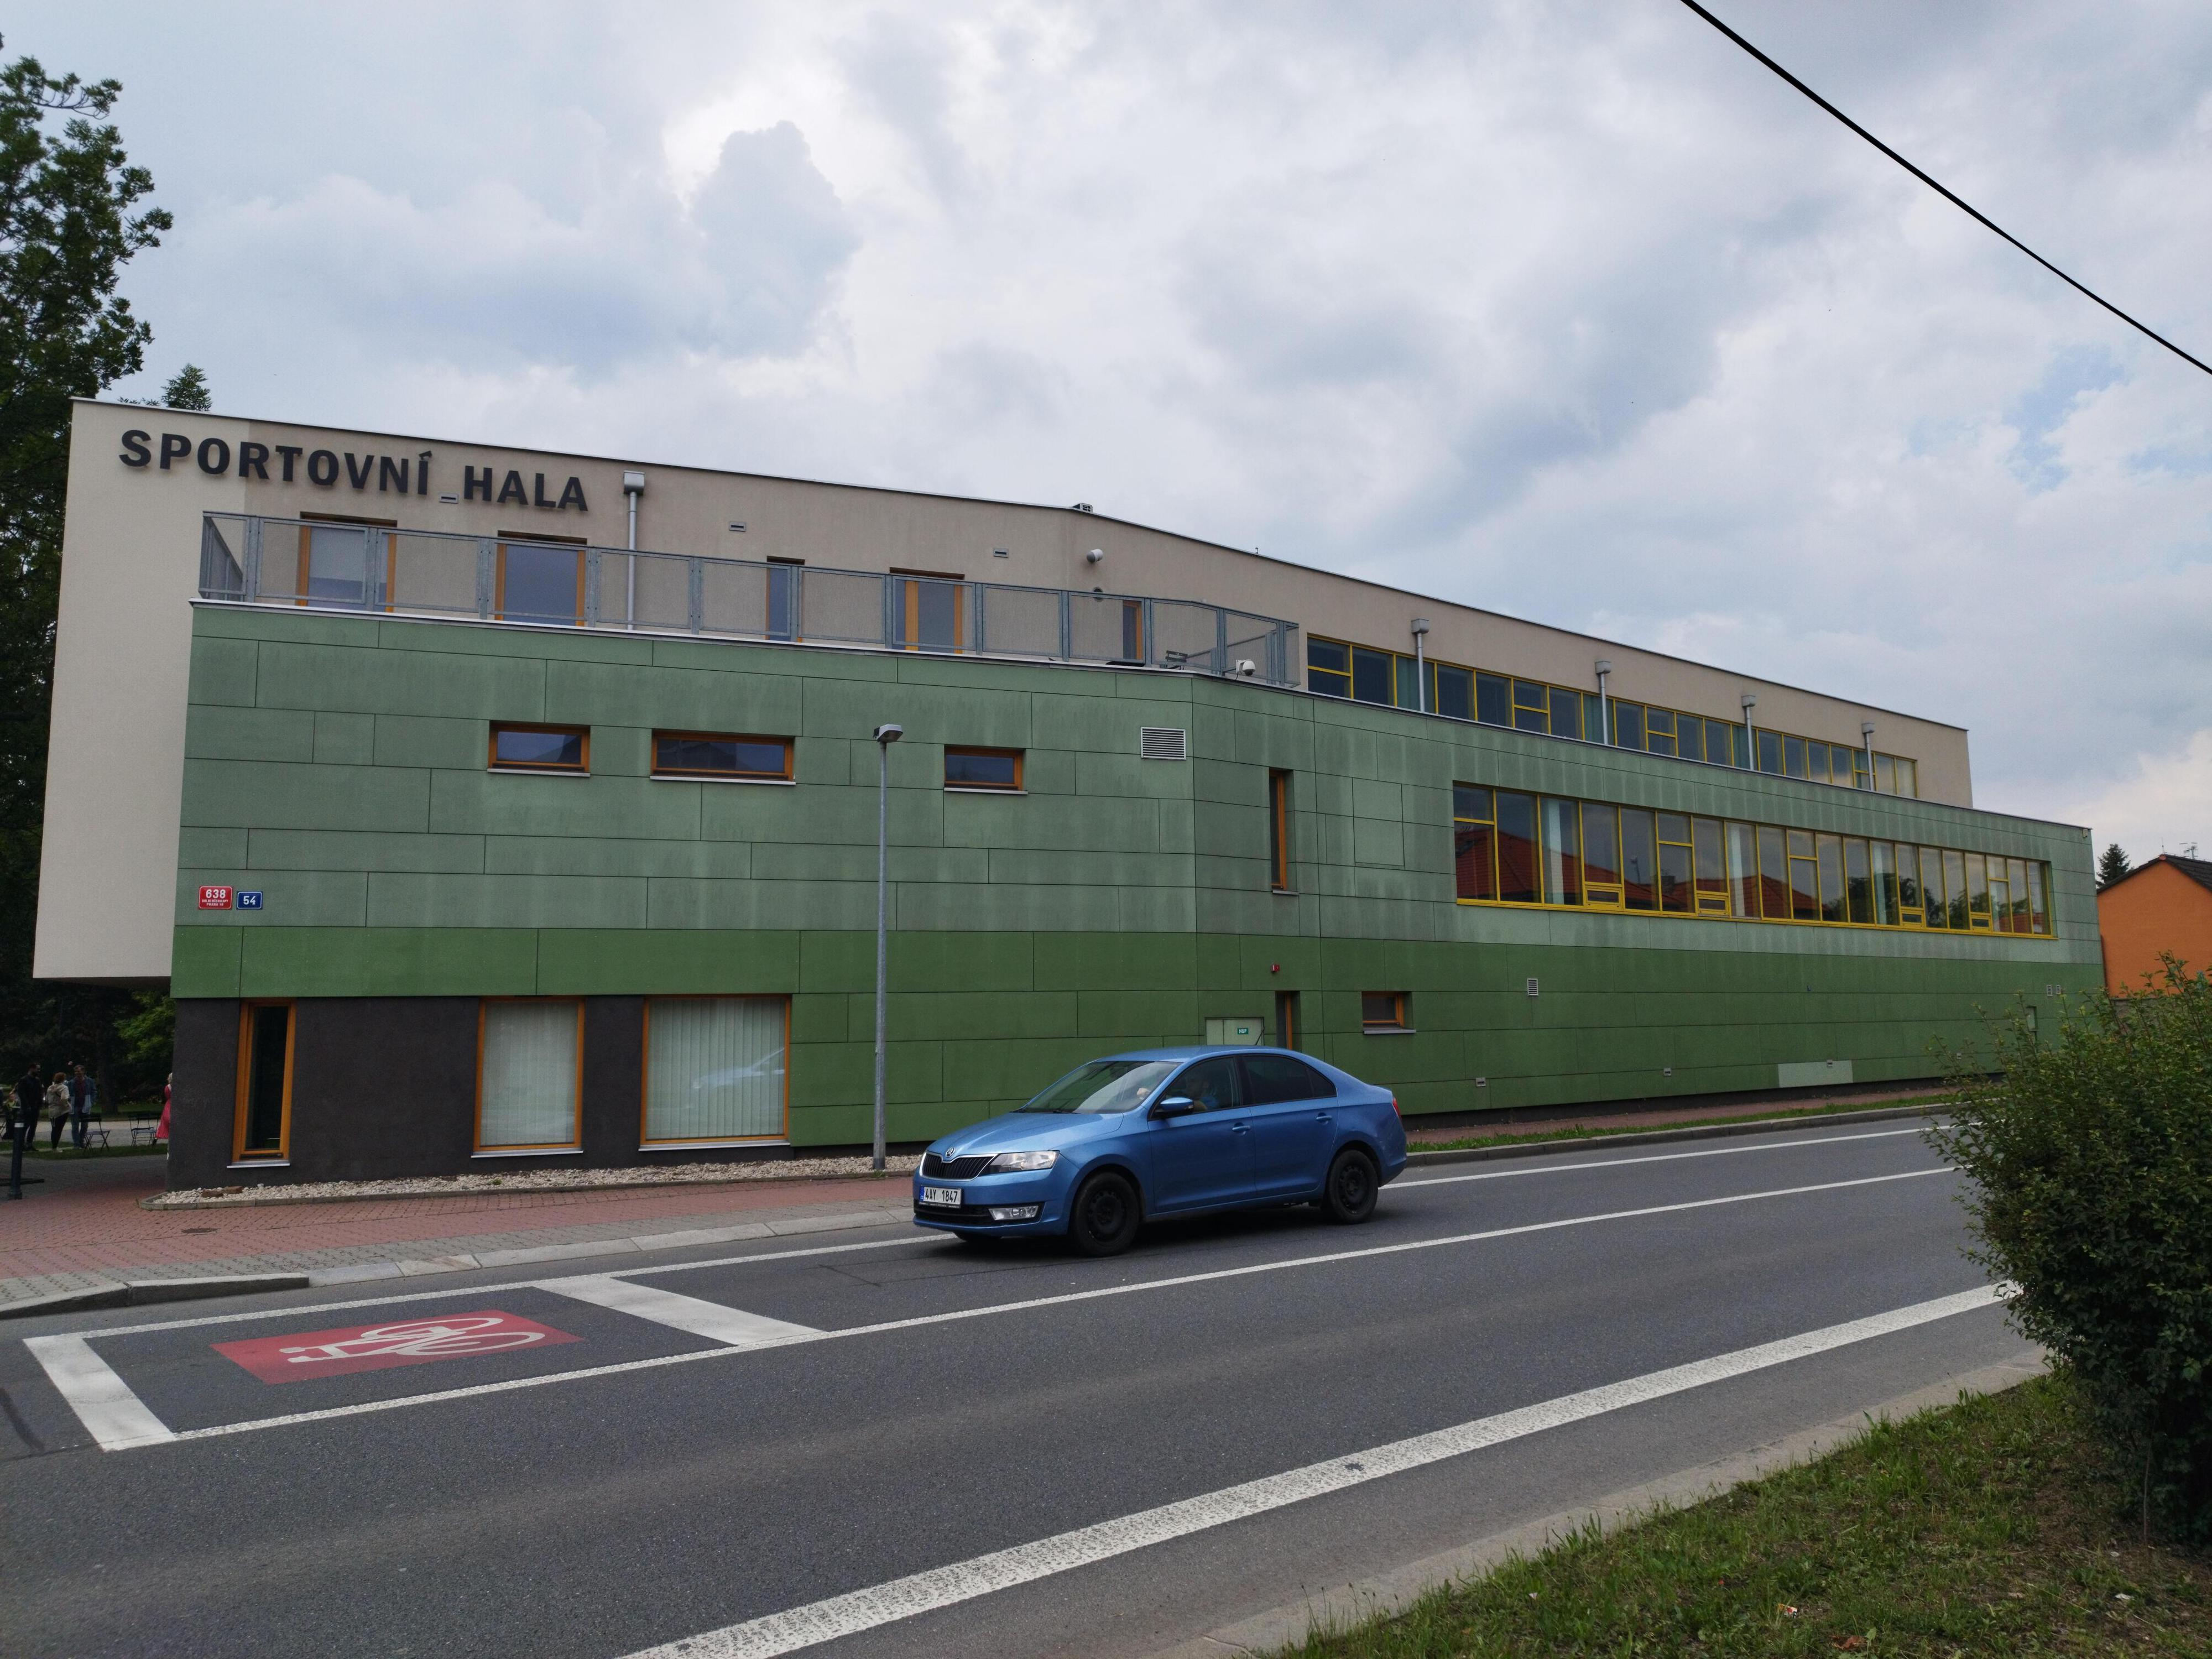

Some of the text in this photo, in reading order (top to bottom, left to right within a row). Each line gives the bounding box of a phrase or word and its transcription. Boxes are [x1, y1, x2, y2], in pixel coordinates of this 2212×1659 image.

[118, 429, 588, 512] SPORTOVNÍ HALA
[206, 889, 226, 899] 638
[243, 896, 256, 905] 54
[925, 1188, 958, 1202] 4AY 1847
